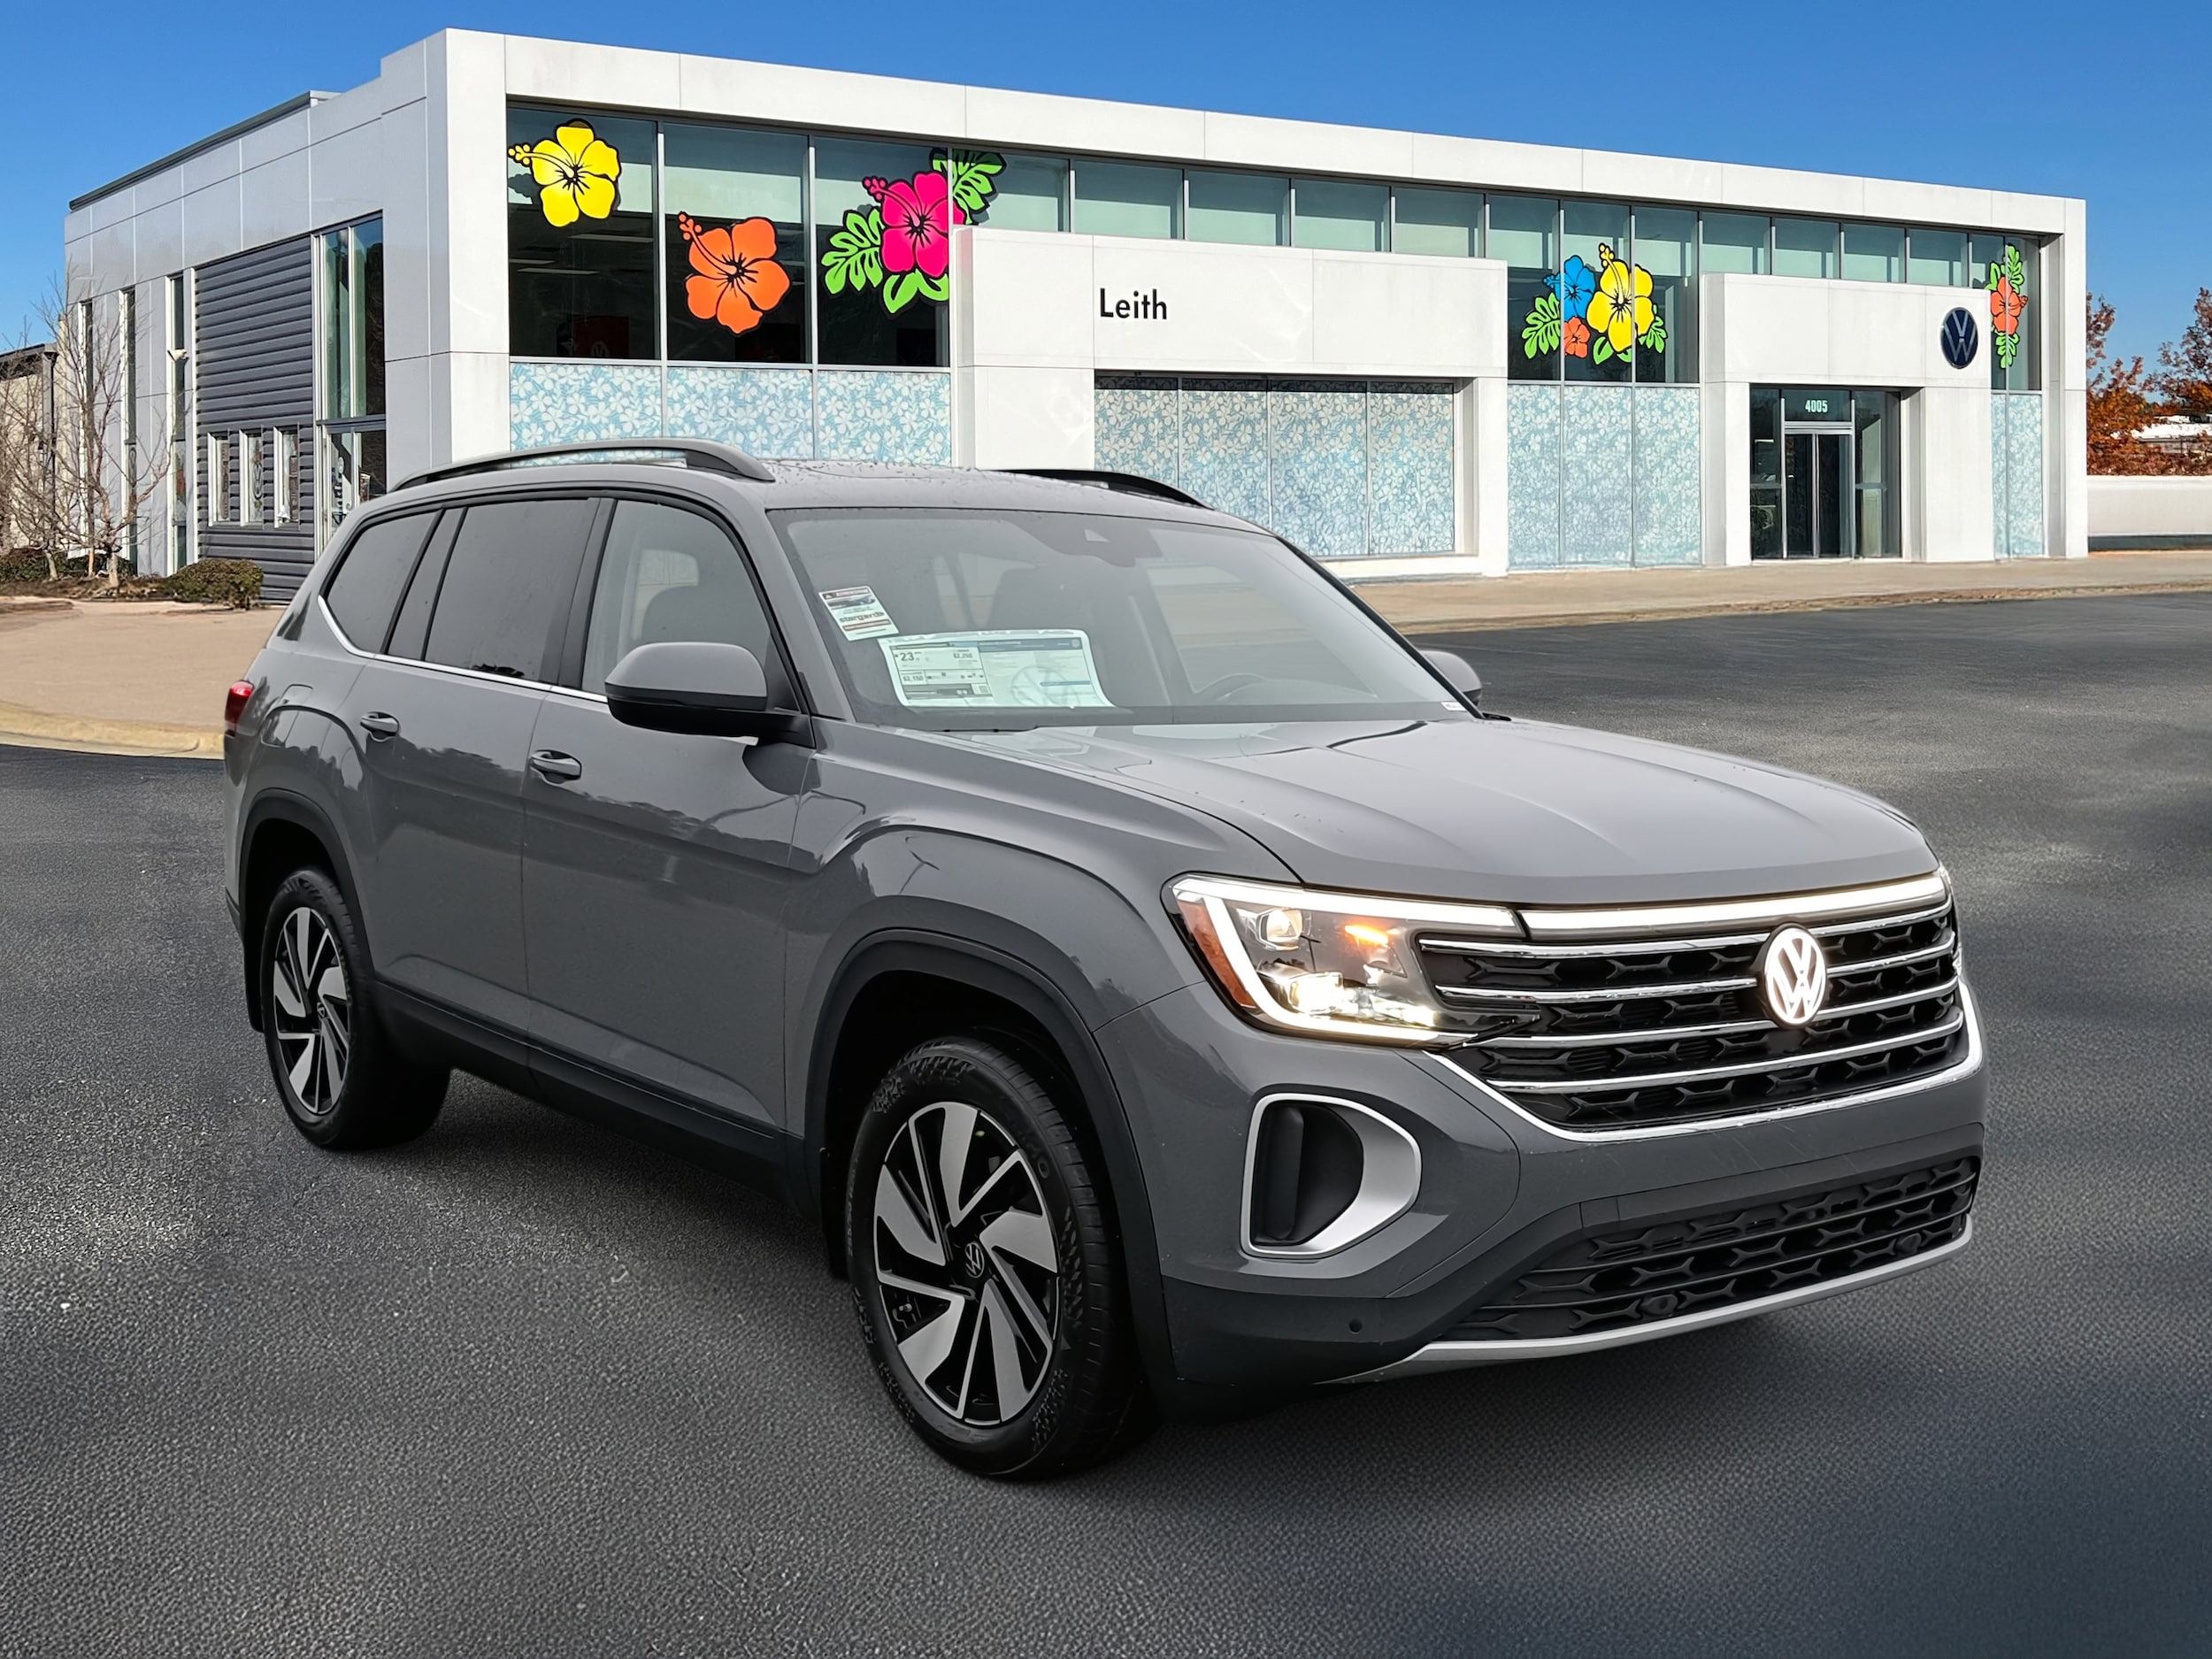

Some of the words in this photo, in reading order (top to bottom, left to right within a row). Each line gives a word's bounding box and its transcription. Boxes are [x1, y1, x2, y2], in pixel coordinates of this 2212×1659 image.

[1100, 288, 1167, 319] Leith
[1805, 399, 1828, 413] 4005
[900, 651, 915, 661] 23
[1764, 927, 1825, 1025] VW
